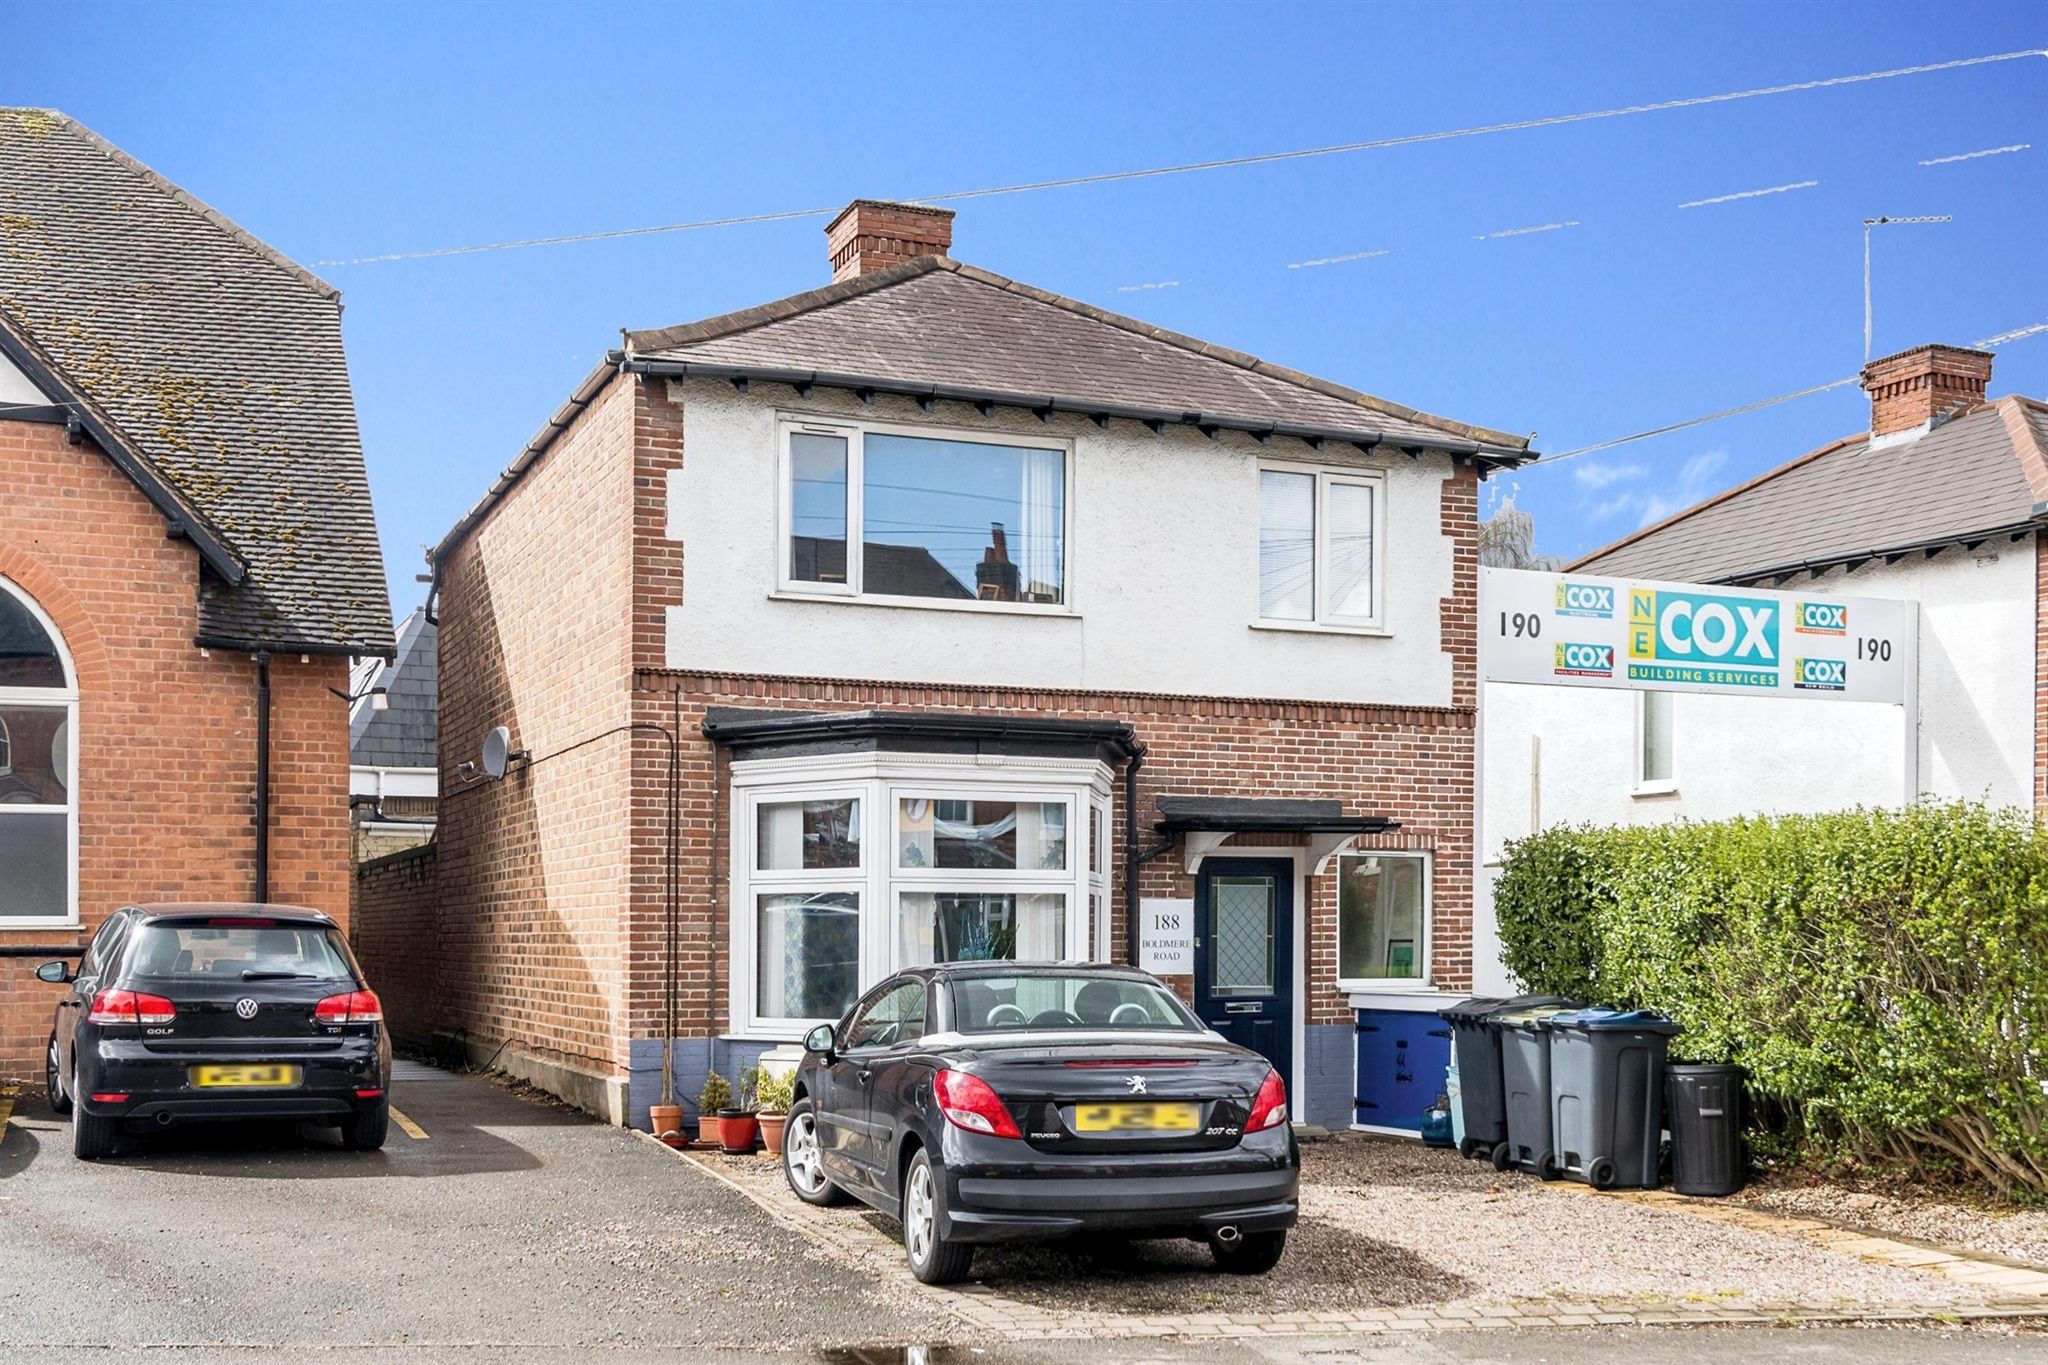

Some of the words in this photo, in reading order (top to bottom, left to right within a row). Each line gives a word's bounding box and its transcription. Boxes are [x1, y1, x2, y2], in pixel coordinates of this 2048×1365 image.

[1567, 587, 1612, 609] COX
[1500, 612, 1541, 638] 190
[1805, 605, 1845, 626] COX
[1660, 600, 1776, 659] COX
[1566, 645, 1611, 668] COX
[1858, 637, 1891, 662] 190
[1629, 667, 1702, 681] BUILDING
[1708, 672, 1776, 685] SERVICES
[1804, 661, 1844, 682] COX
[1155, 914, 1180, 930] 188
[1142, 939, 1191, 949] BOLDMERE
[1153, 952, 1180, 960] ROAD
[1205, 1127, 1225, 1136] 207
